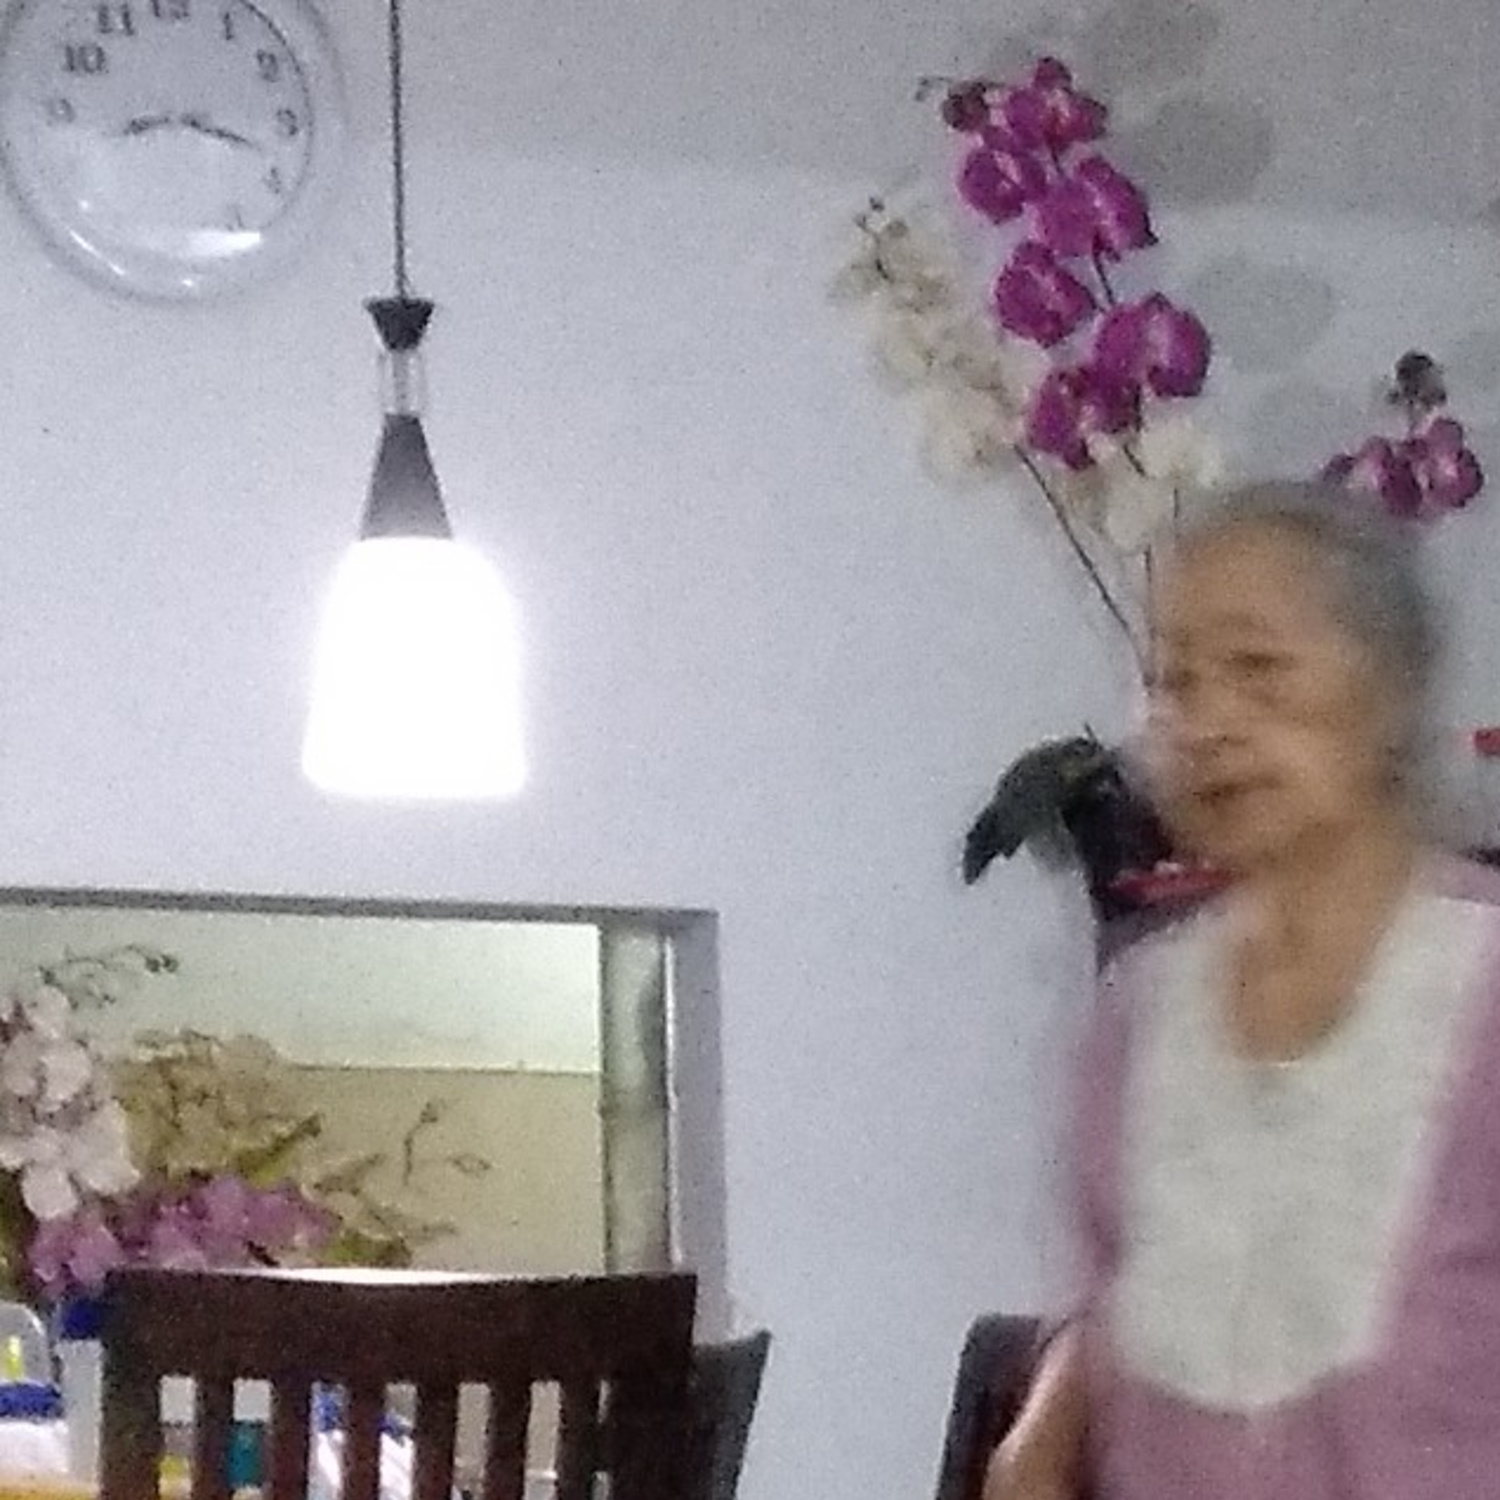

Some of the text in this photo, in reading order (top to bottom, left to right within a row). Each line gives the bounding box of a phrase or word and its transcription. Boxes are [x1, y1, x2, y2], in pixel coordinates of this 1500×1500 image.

[97, 2, 135, 36] 11
[221, 10, 235, 41] 1
[64, 44, 106, 74] 10
